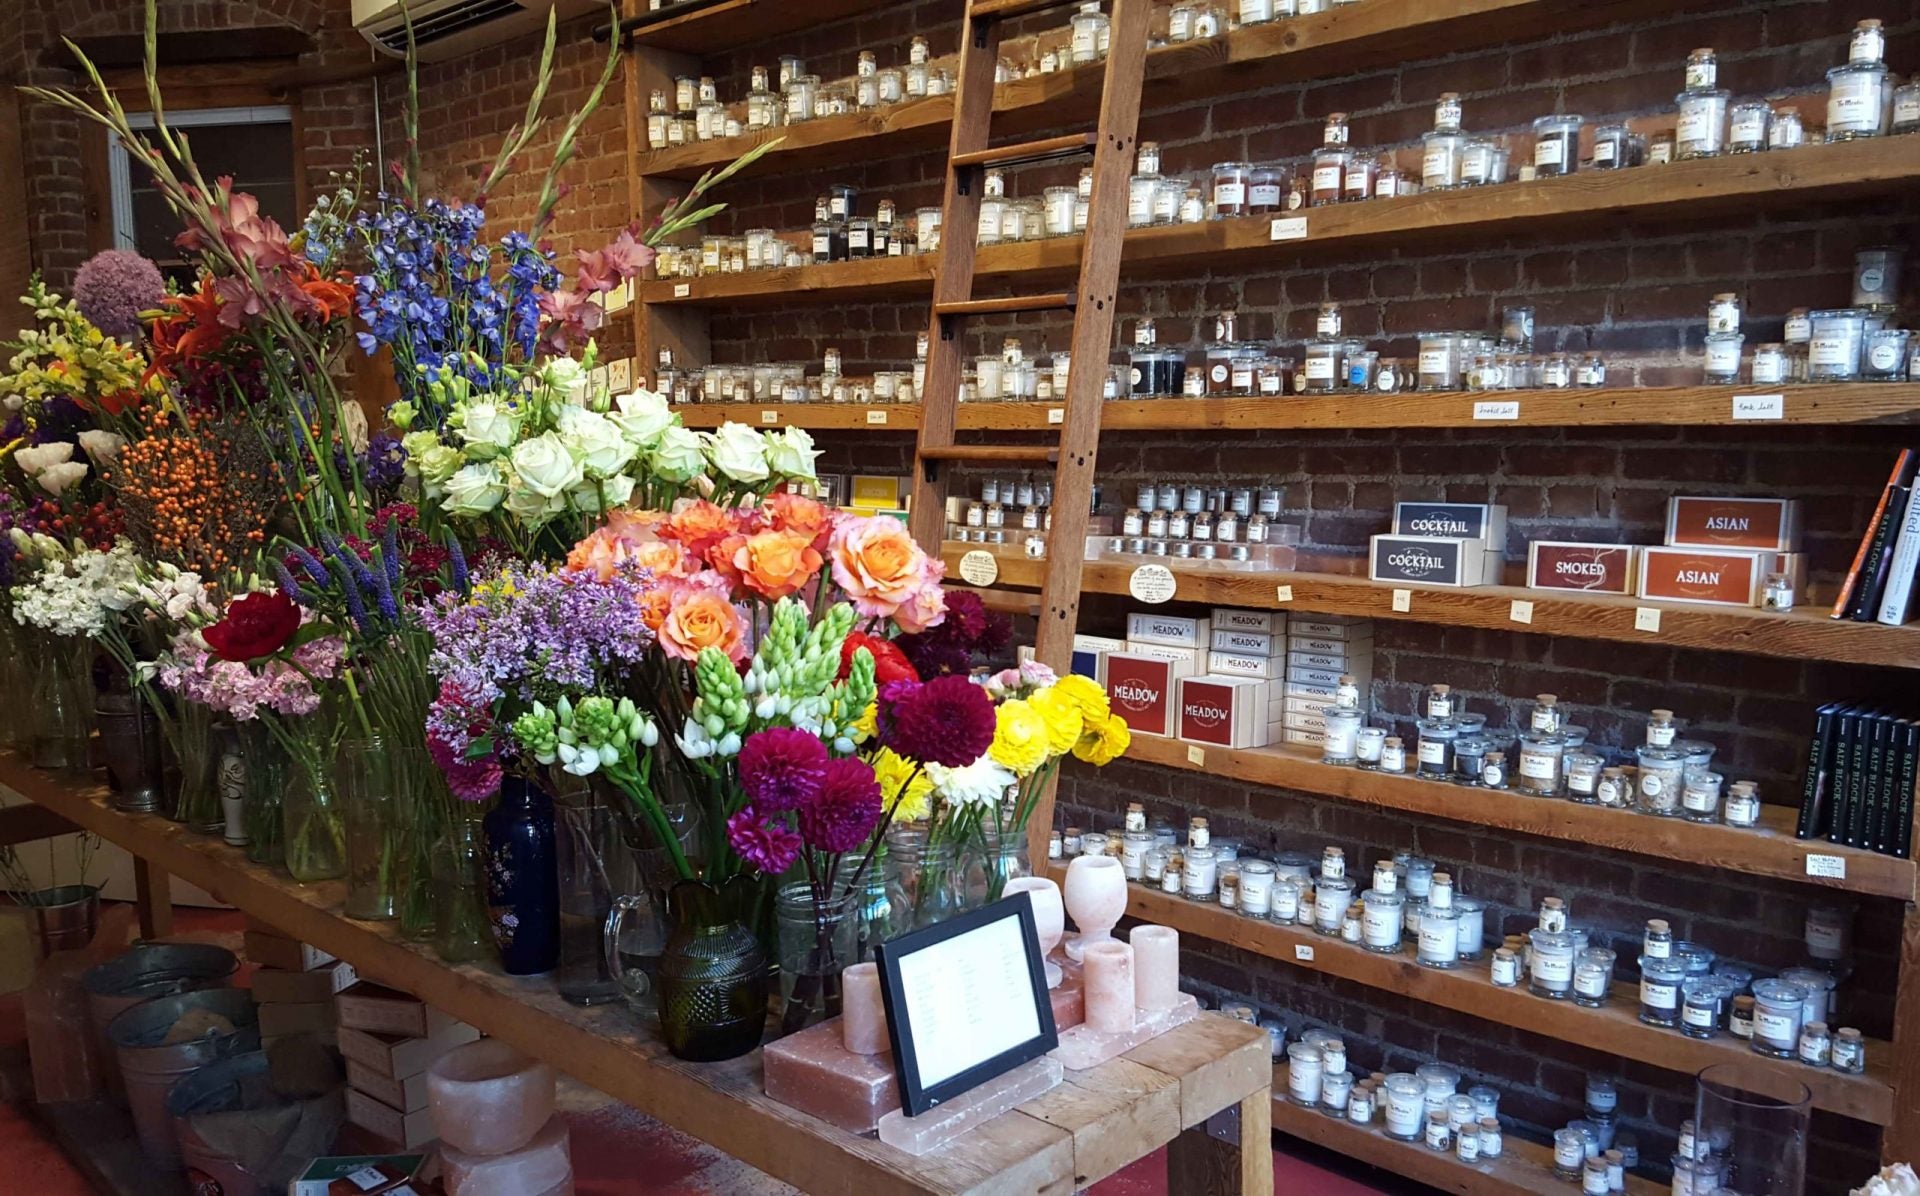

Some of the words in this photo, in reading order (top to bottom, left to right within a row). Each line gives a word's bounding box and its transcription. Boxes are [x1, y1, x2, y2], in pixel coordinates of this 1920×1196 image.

[1411, 519, 1469, 533] COCKTAIL
[1706, 517, 1749, 531] ASIAN
[1877, 513, 1891, 539] SALT
[1387, 554, 1445, 569] COCKTAIL
[1555, 561, 1606, 576] SMOKED
[1676, 570, 1719, 585] ASIAN
[1152, 624, 1185, 637] MEADOW
[1231, 616, 1264, 626] MEADOW
[1230, 637, 1263, 648] MEADOW
[1227, 659, 1260, 670] MEADOW
[1114, 684, 1159, 703] MEADOW
[1184, 704, 1228, 721] MEADOW
[1810, 739, 1820, 764] SALT
[1837, 742, 1846, 766] SALT
[1854, 744, 1863, 769] SALT
[1871, 747, 1880, 772] SALT
[1886, 749, 1896, 774] SALT
[1903, 752, 1913, 778] SALT
[1805, 765, 1816, 797] BLOCK
[1834, 768, 1843, 801] BLOCK
[1851, 771, 1860, 803] BLOCK
[1867, 773, 1877, 806] BLOCK
[1882, 776, 1892, 810] BLOCK
[1900, 780, 1910, 813] BLOCK
